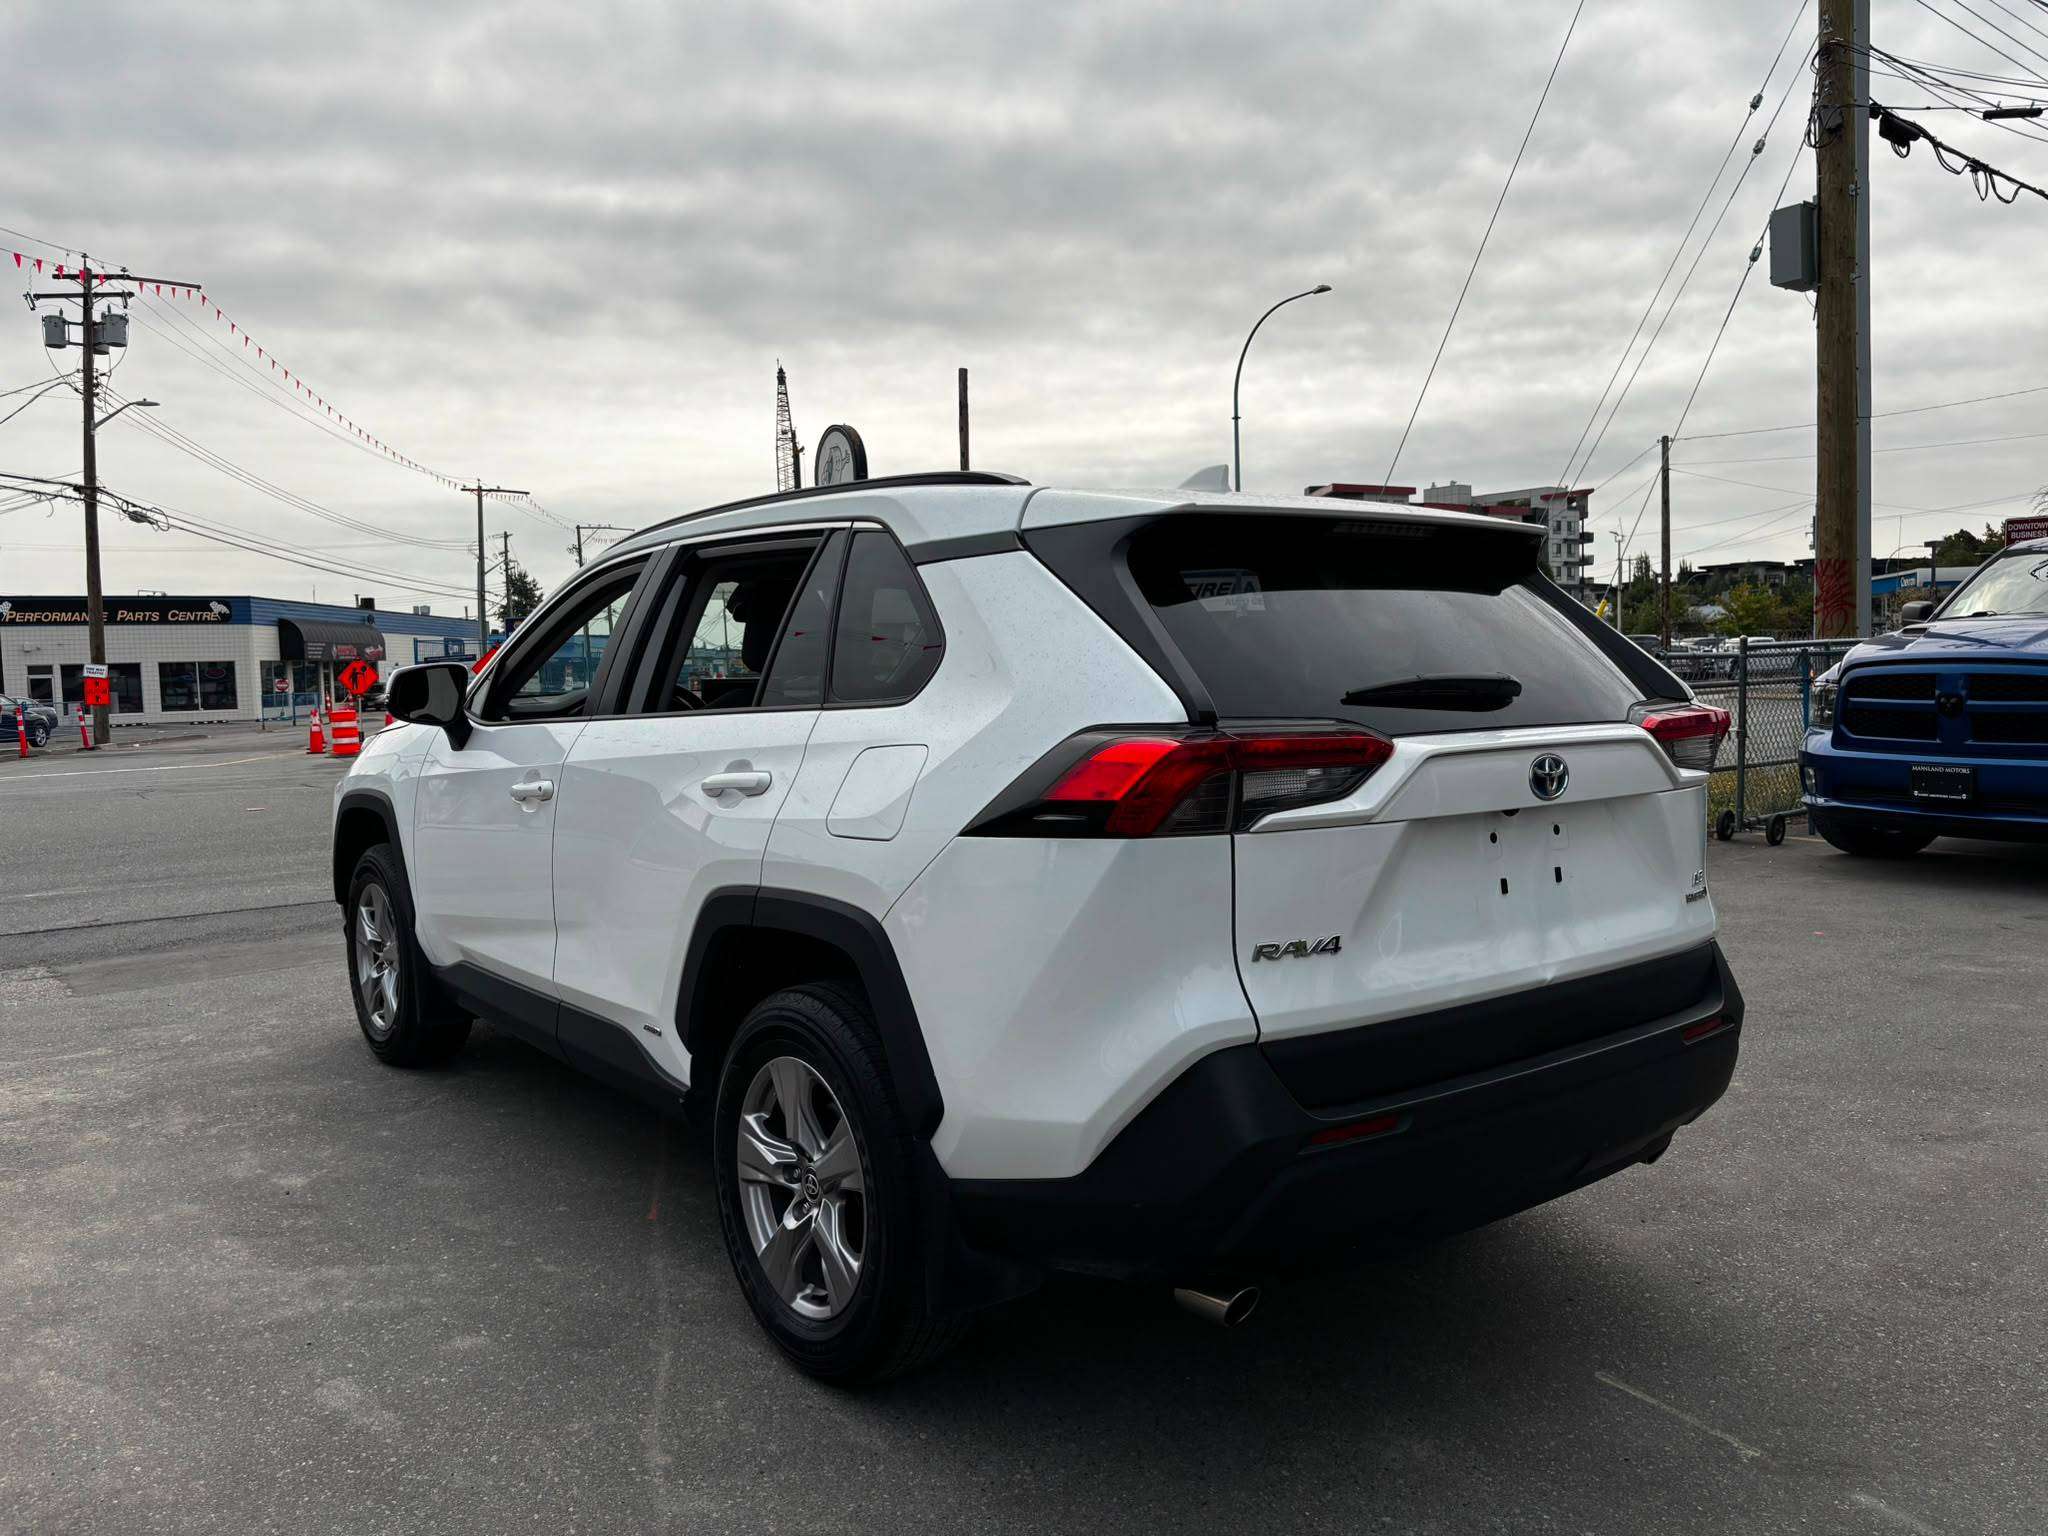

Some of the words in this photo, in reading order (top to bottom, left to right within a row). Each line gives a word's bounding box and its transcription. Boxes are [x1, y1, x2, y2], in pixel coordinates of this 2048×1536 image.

[2011, 529, 2048, 540] BUSINESS
[5, 610, 108, 623] PERFORMANE
[117, 609, 160, 622] PARTS
[168, 609, 219, 622] CENTRE
[1251, 934, 1343, 962] RAV4
